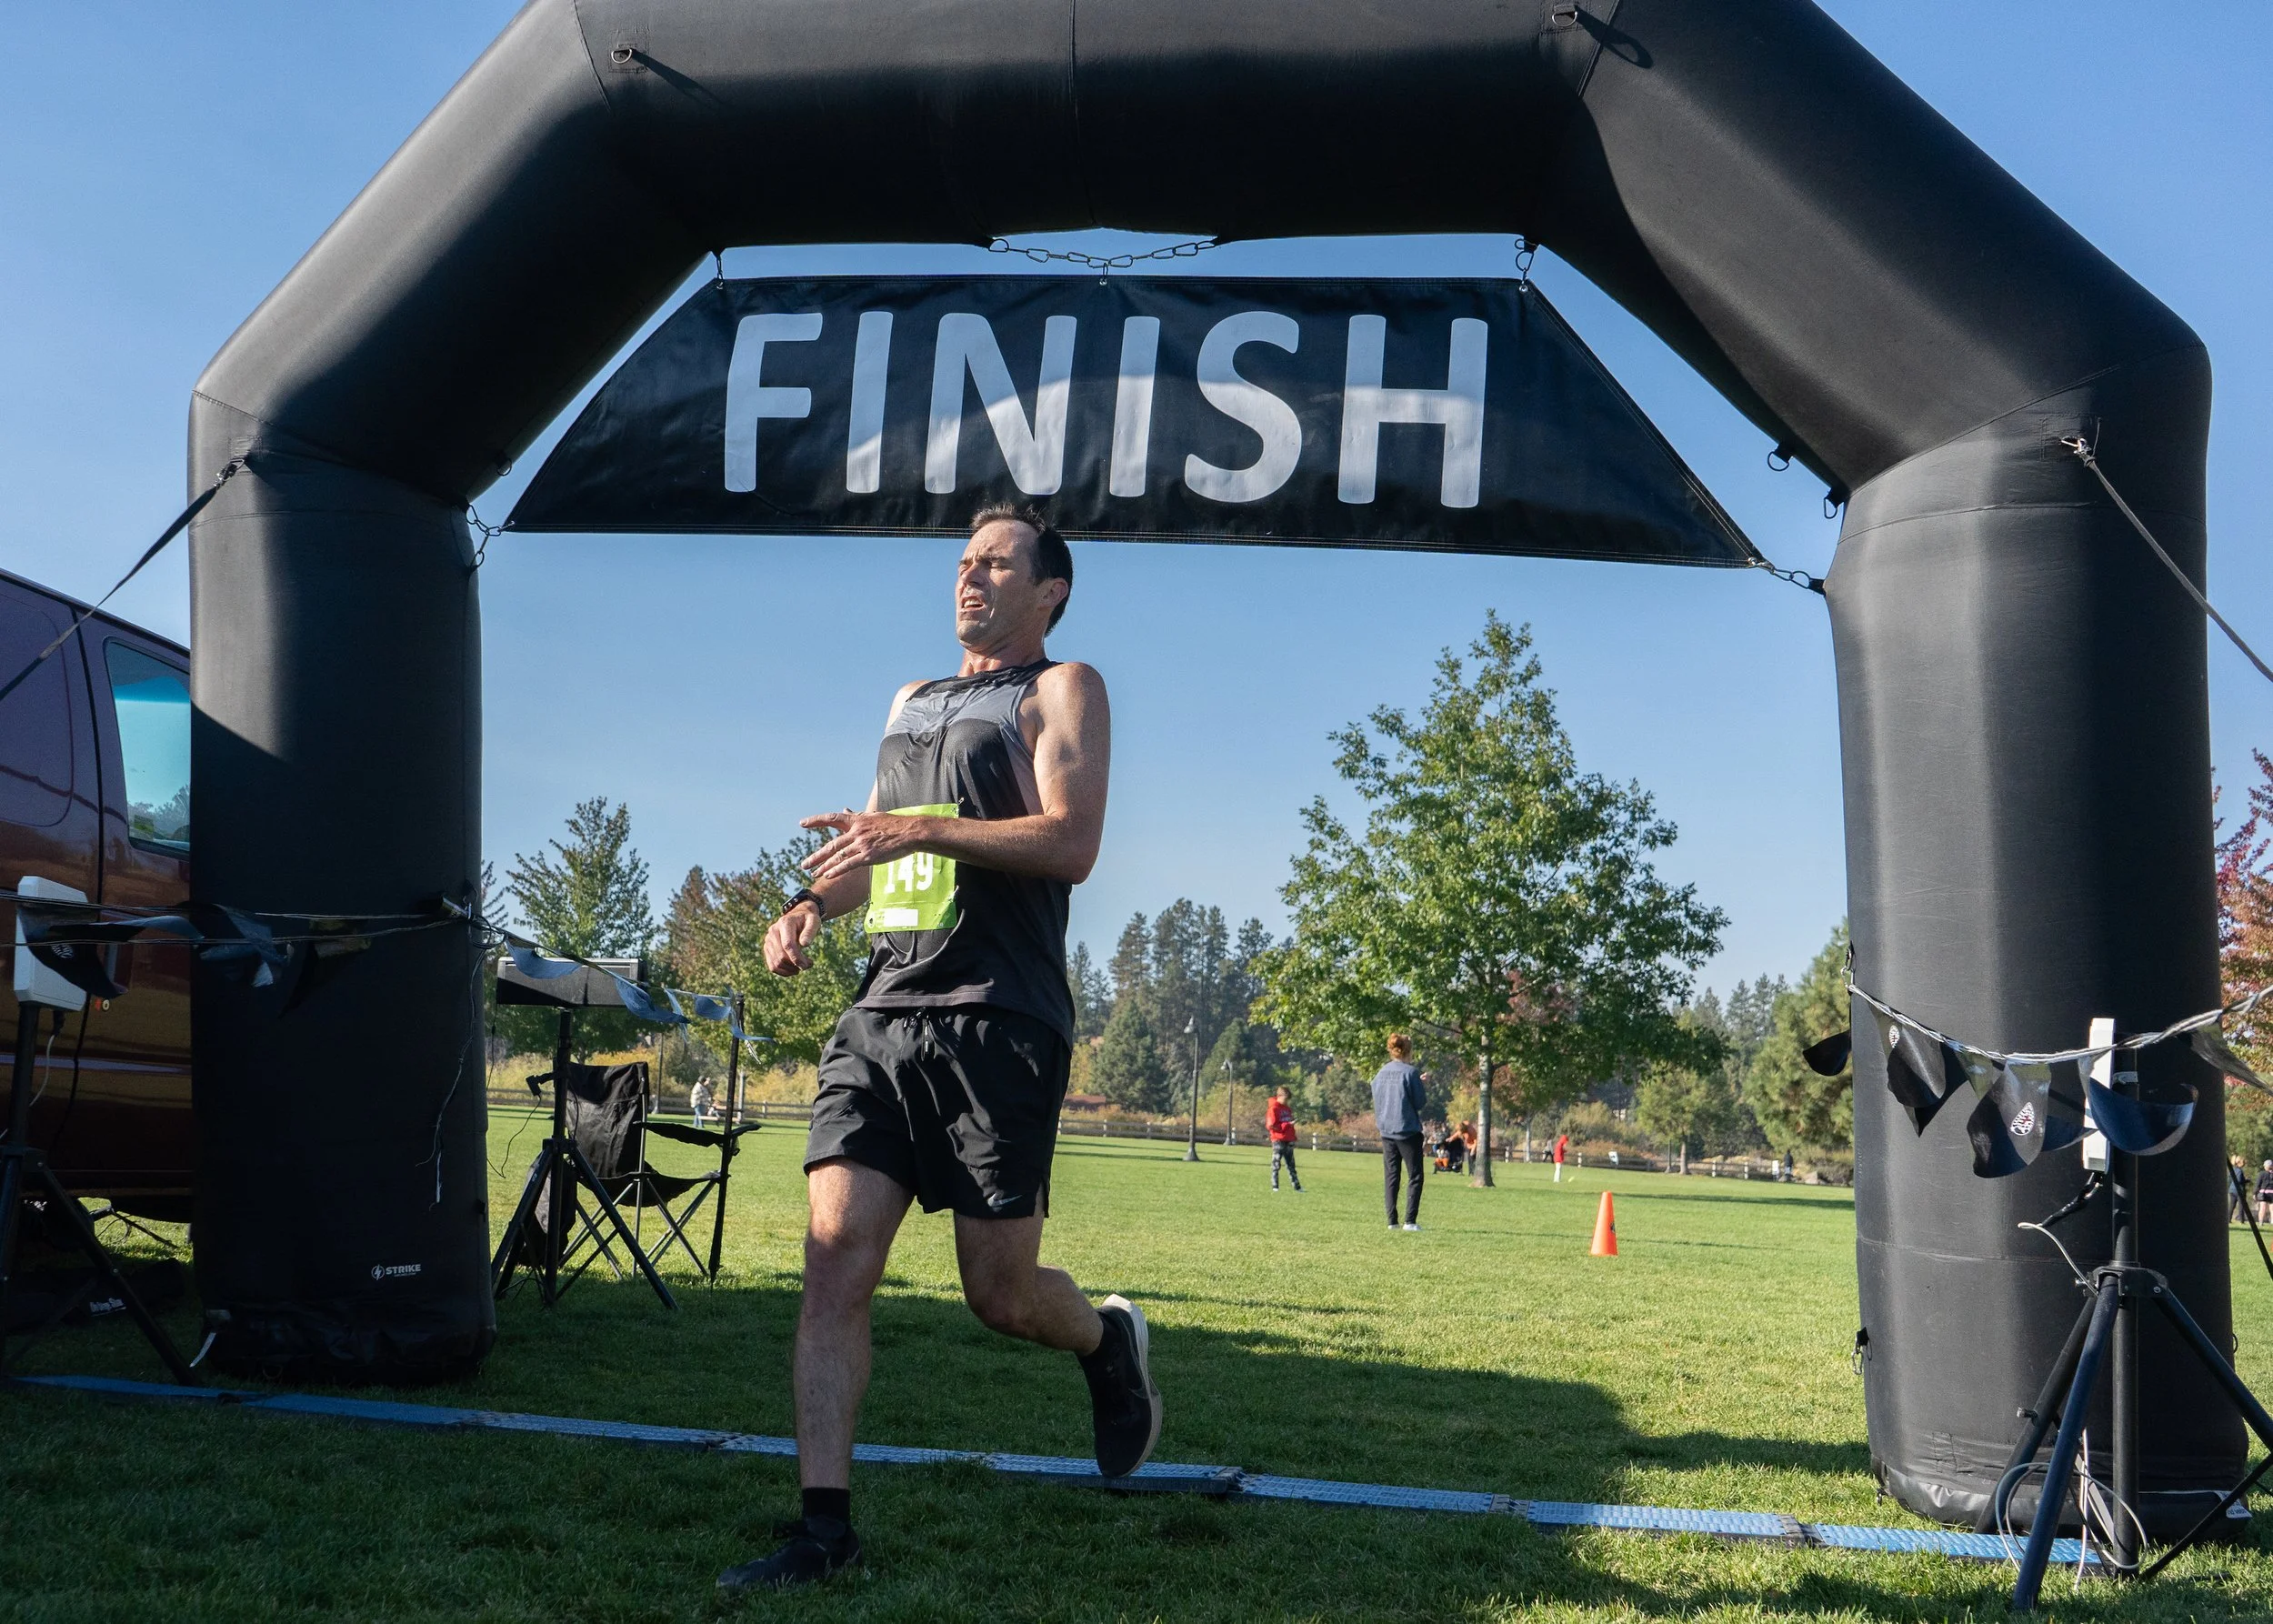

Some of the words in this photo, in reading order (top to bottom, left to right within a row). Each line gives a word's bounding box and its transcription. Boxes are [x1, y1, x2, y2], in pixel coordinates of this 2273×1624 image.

[724, 311, 1488, 509] FINISH
[883, 851, 934, 895] 149
[386, 1264, 422, 1275] STRIKE
